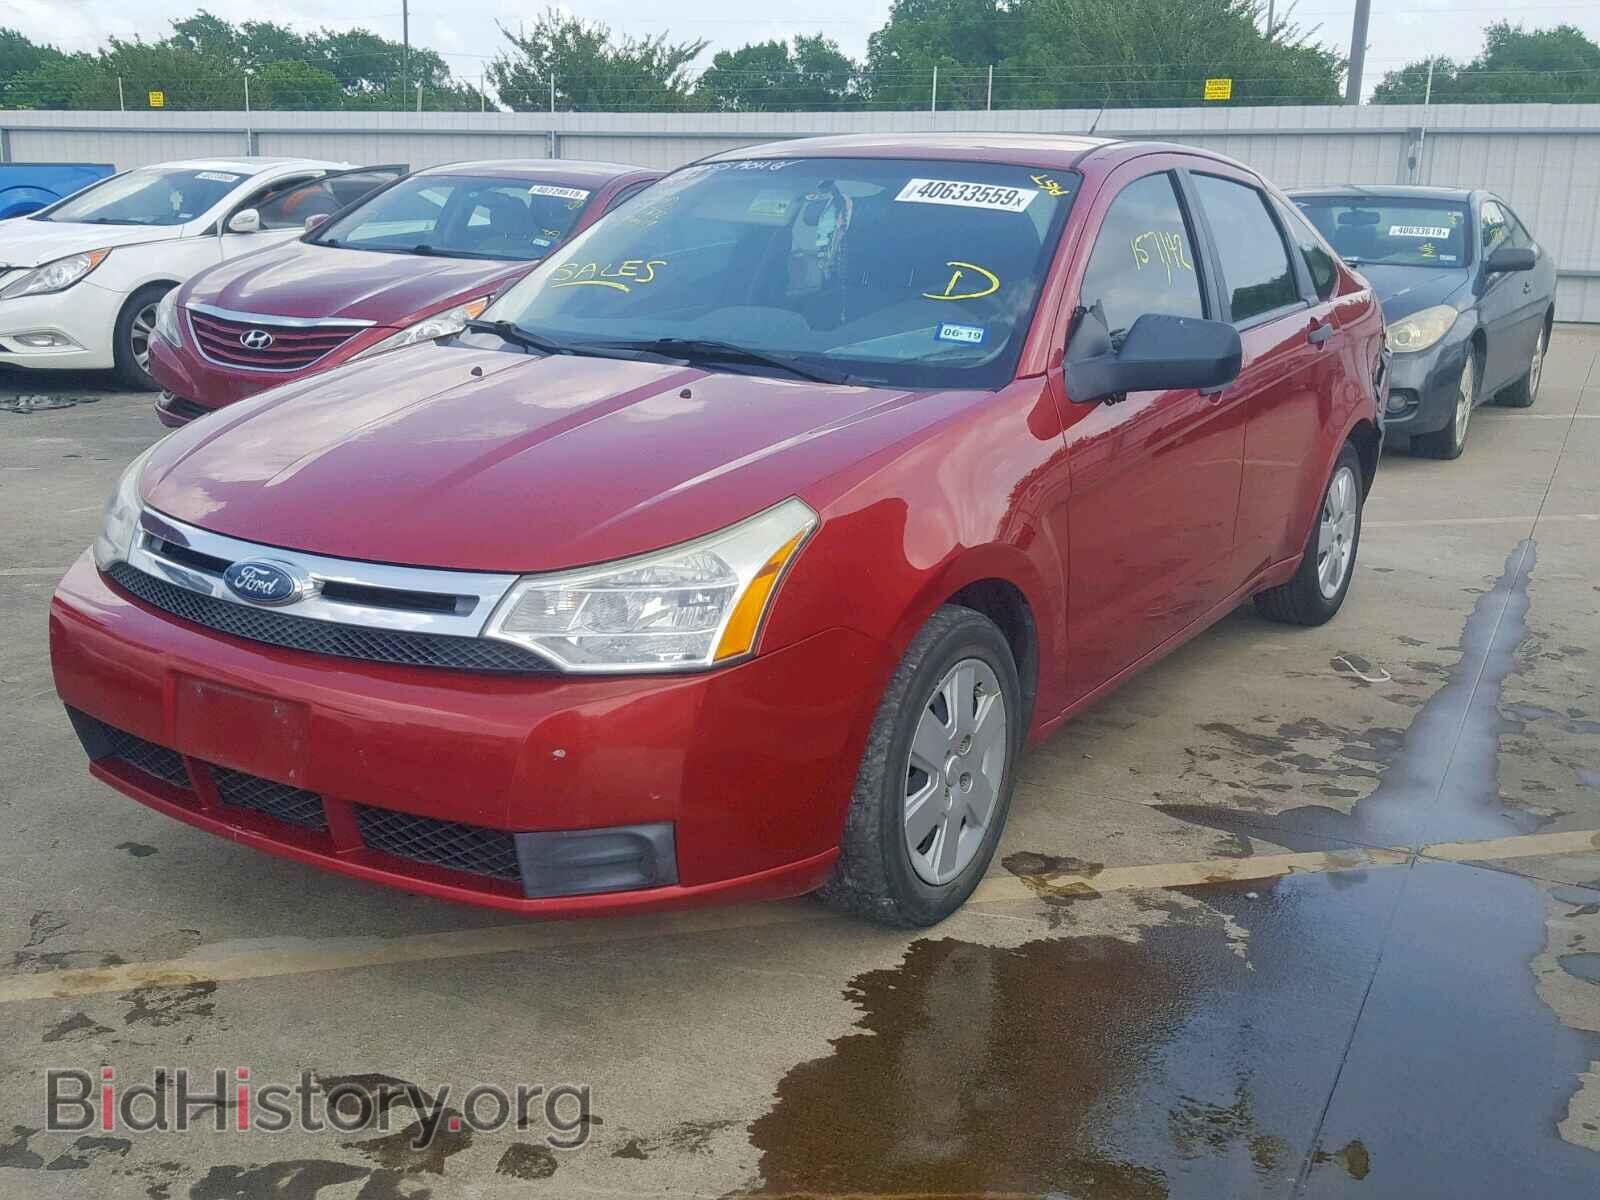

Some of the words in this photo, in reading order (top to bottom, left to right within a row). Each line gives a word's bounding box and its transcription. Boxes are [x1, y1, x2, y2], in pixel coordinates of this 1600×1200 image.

[551, 260, 667, 283] SALES
[922, 261, 1000, 300] D
[234, 566, 279, 595] Ford
